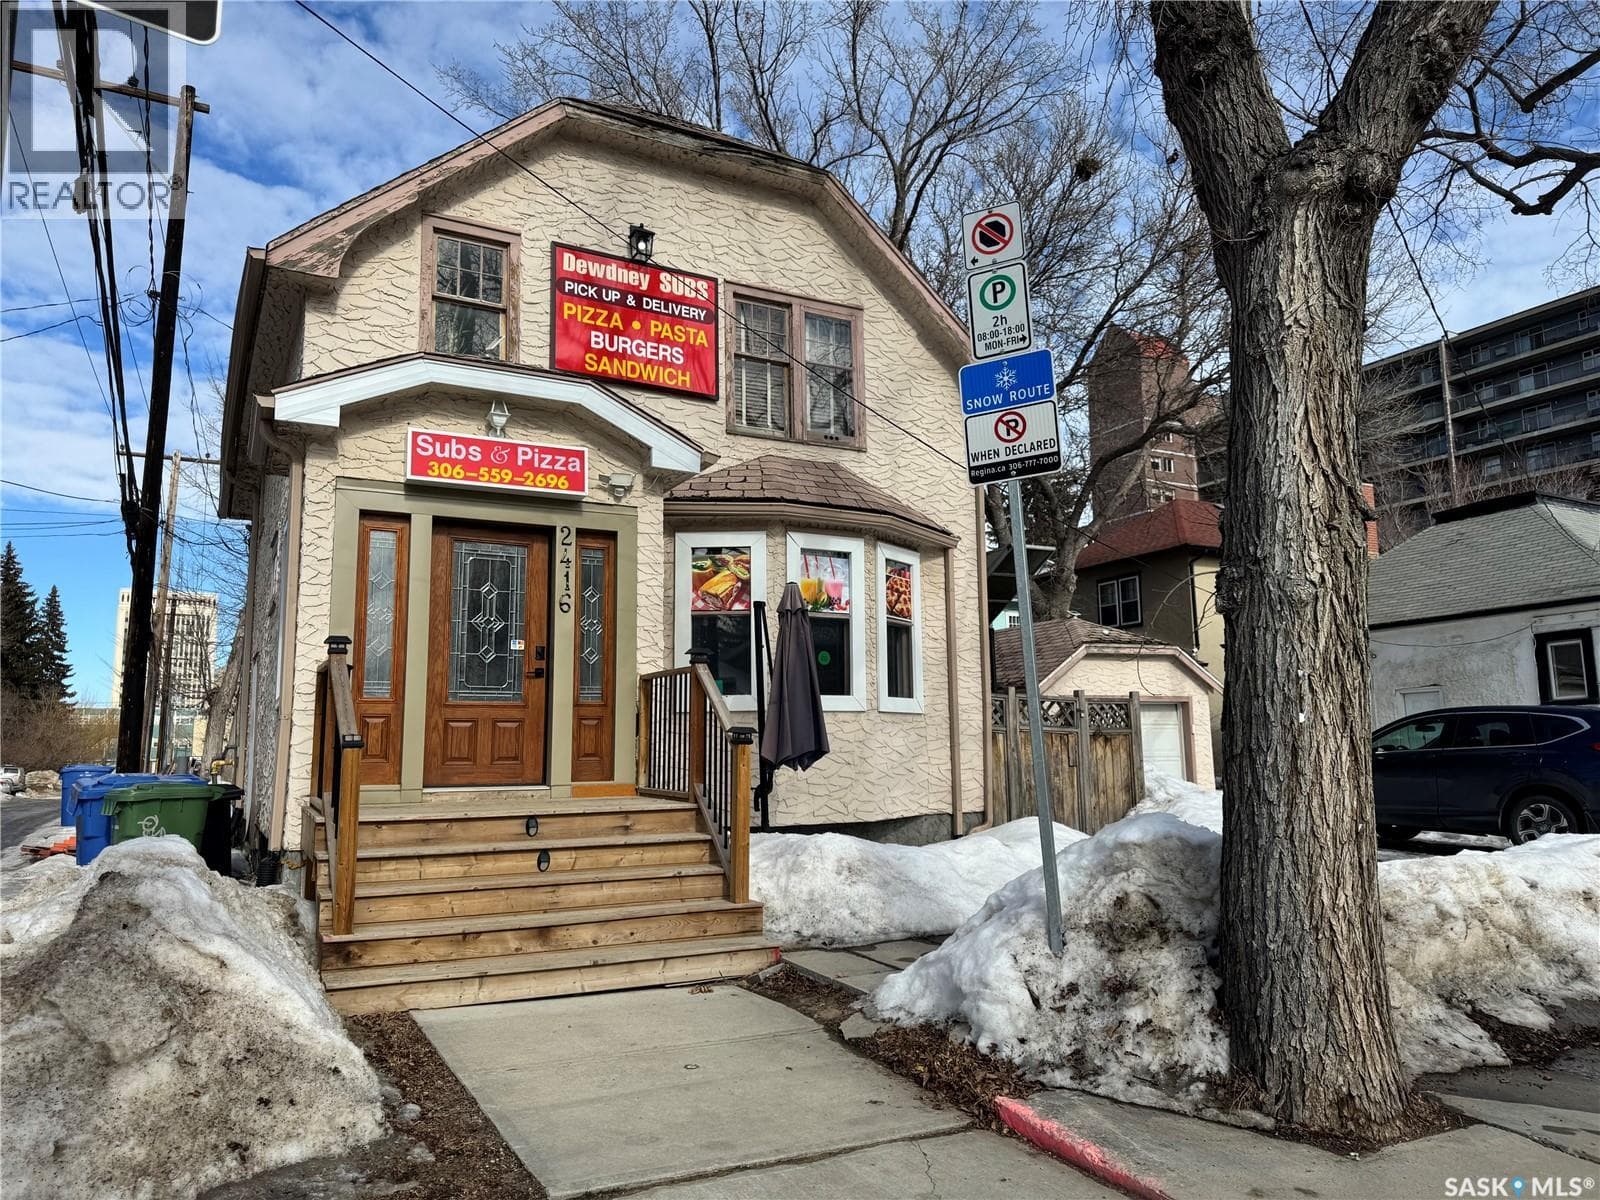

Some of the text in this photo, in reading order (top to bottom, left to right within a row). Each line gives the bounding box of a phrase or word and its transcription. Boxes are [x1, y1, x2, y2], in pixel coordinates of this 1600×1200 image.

[562, 252, 650, 291] Dewdney
[564, 280, 707, 321] PICK UP & DELIVERY
[991, 280, 1006, 304] P
[563, 302, 709, 348] PIZZA PASTA
[977, 323, 1026, 342] 08:00-18:00
[992, 314, 1008, 328] 2h
[590, 330, 684, 365] BURGERS
[984, 335, 1020, 352] MON-FRI
[584, 353, 691, 387] SANDWICH
[966, 383, 1050, 411] SNOW ROUTE
[416, 434, 581, 473] Subs & Pizza
[970, 438, 1056, 463] WHEN DECLARED
[427, 461, 569, 490] 306-559-2696
[970, 455, 1059, 478] Regina.ca 306-777-7000
[559, 526, 573, 614] 2416
